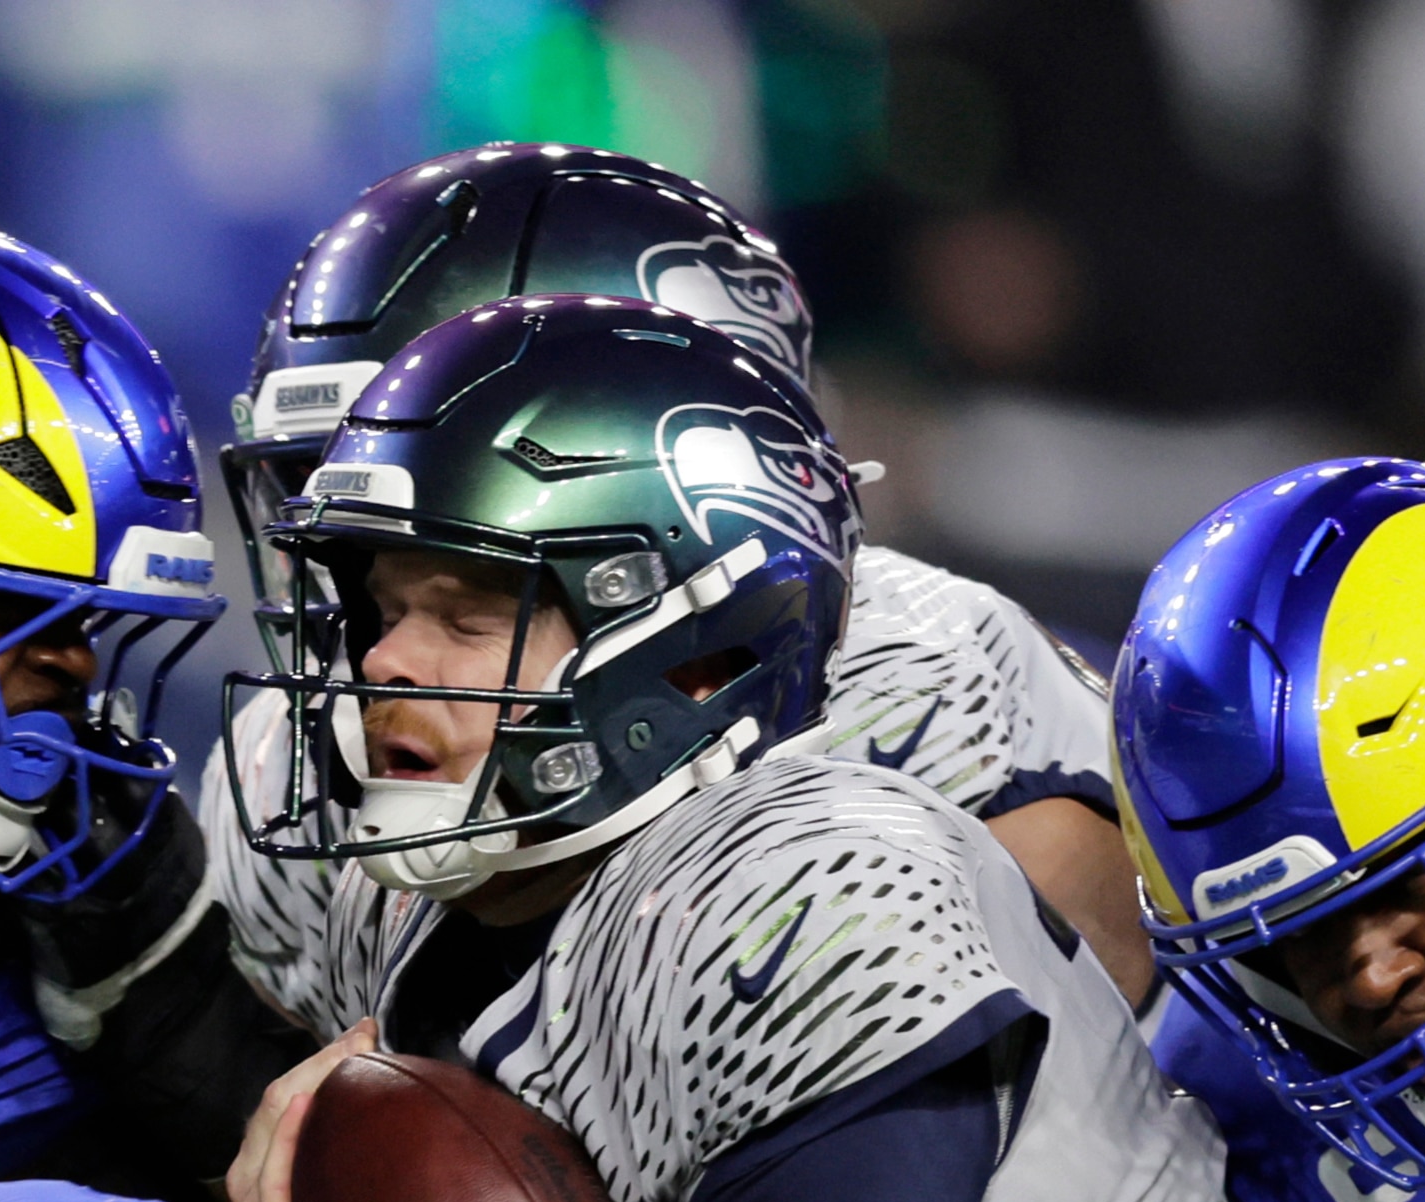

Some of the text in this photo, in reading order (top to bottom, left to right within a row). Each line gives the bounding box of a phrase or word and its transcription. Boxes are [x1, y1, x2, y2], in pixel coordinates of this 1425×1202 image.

[275, 381, 341, 413] SEAHAWKS
[314, 470, 372, 497] SEAHAWKS
[146, 553, 214, 585] RAMS
[1205, 856, 1289, 907] RAMS
